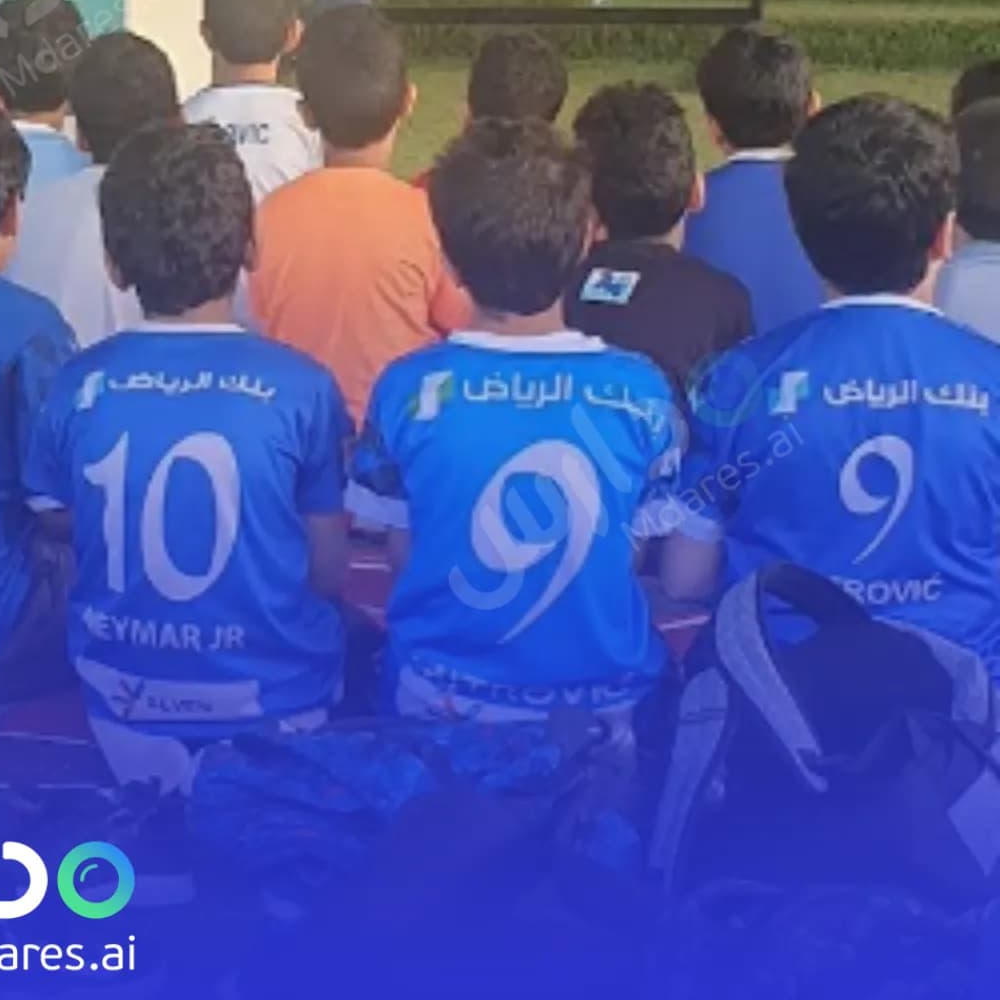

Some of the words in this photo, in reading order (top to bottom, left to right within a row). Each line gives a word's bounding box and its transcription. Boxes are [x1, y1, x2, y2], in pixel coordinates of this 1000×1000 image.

[108, 370, 212, 396] الرياض
[219, 372, 278, 403] بنك
[463, 371, 574, 409] الرياض
[823, 378, 917, 409] الرياض
[922, 382, 990, 416] بنك
[83, 430, 242, 602] 10
[839, 433, 914, 566] 9
[470, 437, 602, 645] 9
[208, 625, 246, 651] JR
